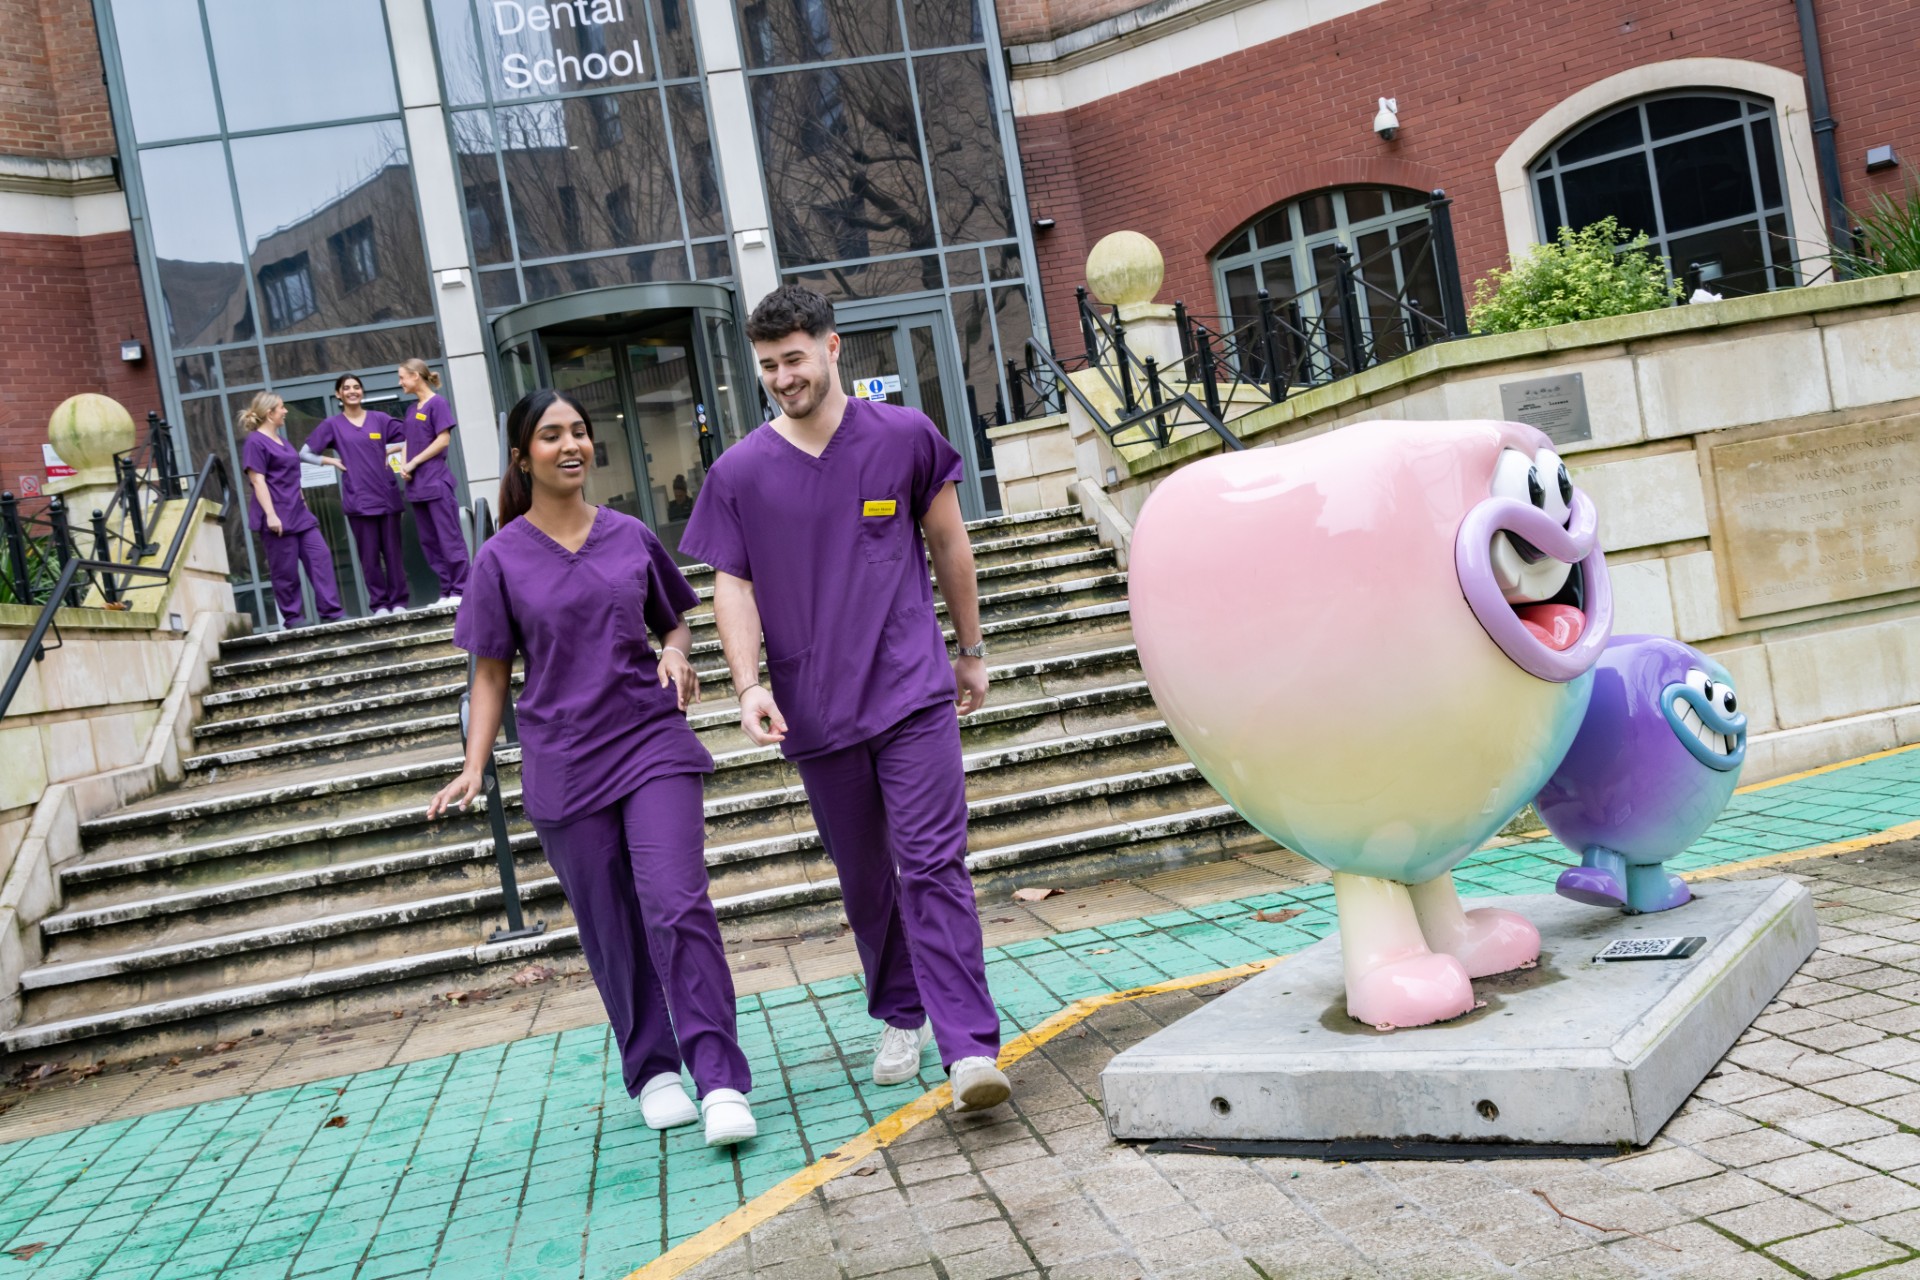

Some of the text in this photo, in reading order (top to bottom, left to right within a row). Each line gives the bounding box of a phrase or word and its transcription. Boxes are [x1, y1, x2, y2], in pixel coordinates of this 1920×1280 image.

[493, 0, 624, 36] Dental
[502, 40, 644, 89] School
[1773, 432, 1914, 464] THIS FOUNDATION STONE
[1794, 457, 1894, 481] WAS UNVEILED BY
[1740, 502, 1761, 513] THE
[1765, 496, 1796, 510] RIGHT
[1800, 486, 1857, 504] REVEREND
[1800, 500, 1903, 525] BISHOP OF BRISTOL
[1796, 536, 1812, 547] ON
[1819, 553, 1836, 565] ON
[1884, 543, 1898, 553] OF
